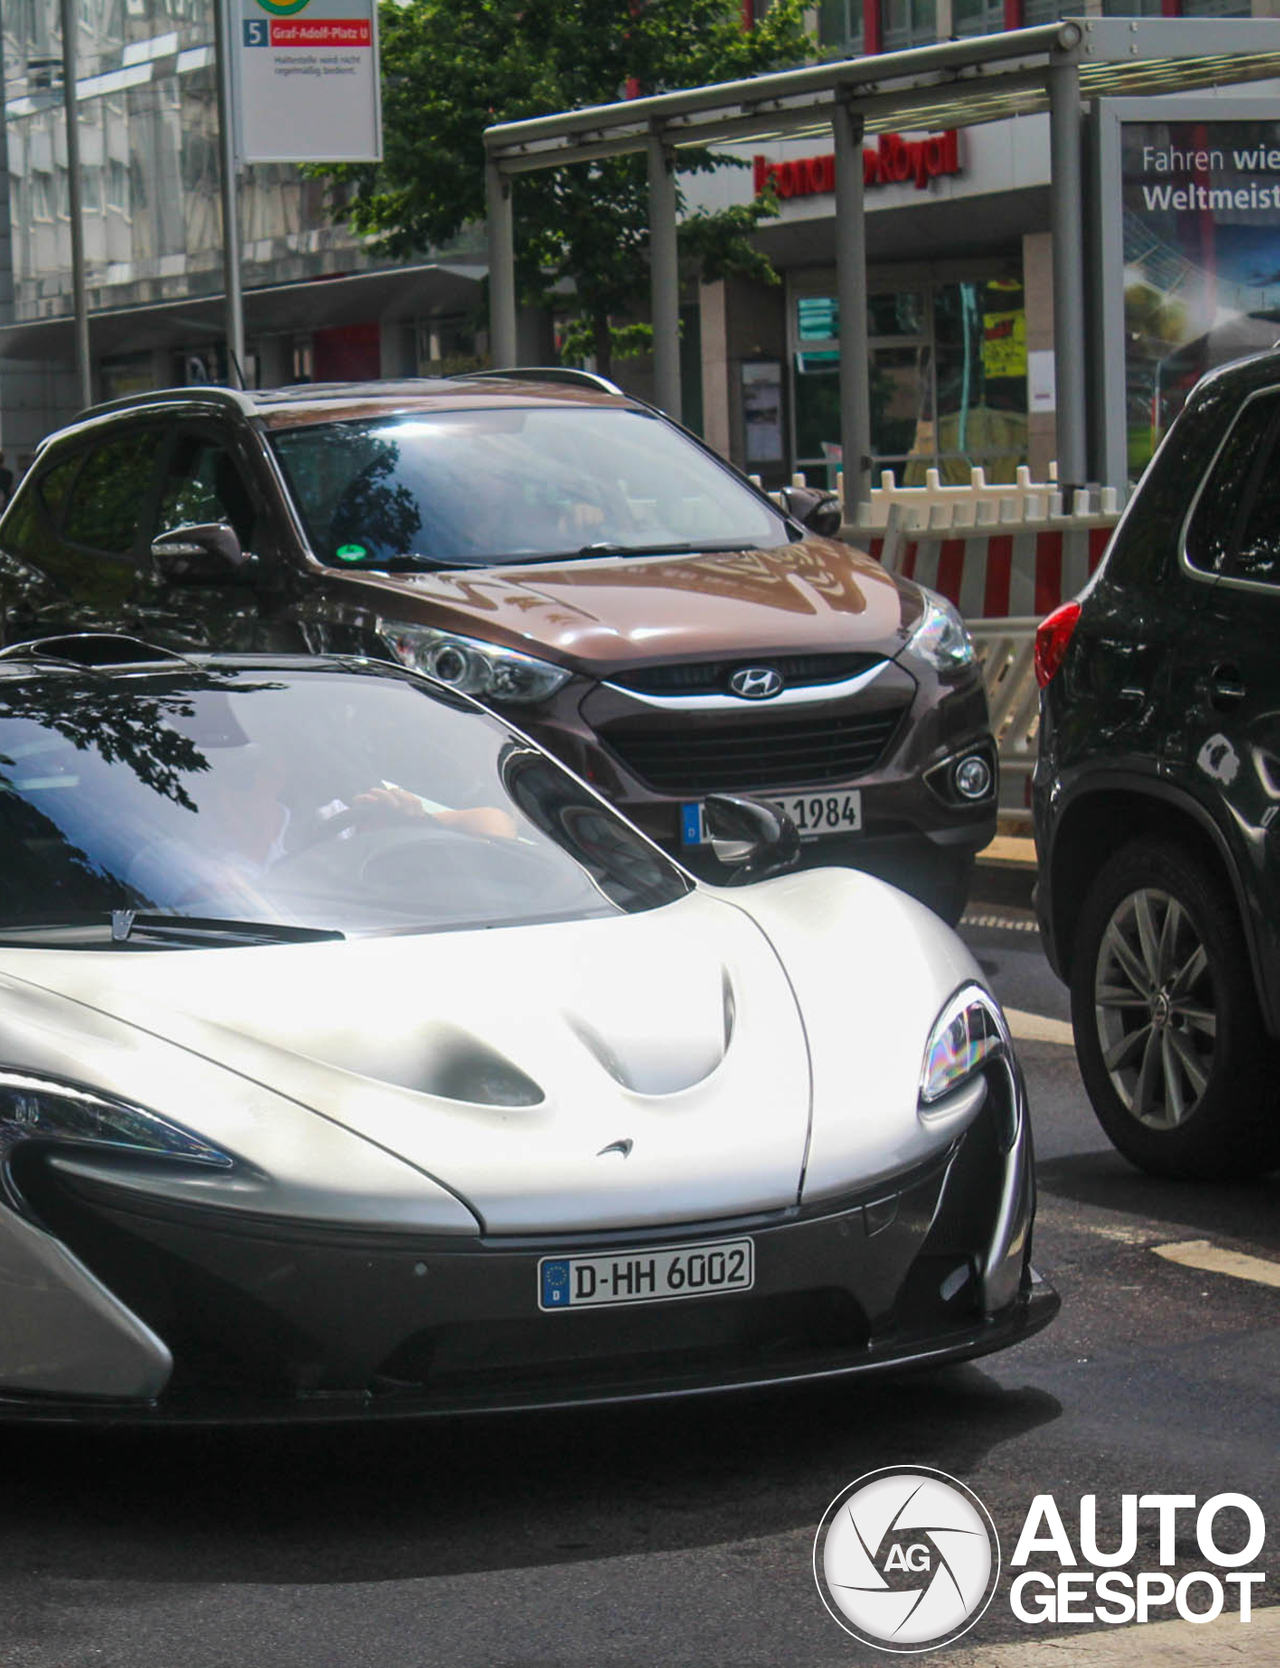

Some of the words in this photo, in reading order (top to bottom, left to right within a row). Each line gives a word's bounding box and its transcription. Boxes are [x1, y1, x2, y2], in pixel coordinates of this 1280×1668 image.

[249, 22, 261, 45] 5
[272, 26, 357, 40] Graf-Adolf-Platz
[1143, 144, 1224, 172] Fahren
[1233, 144, 1280, 170] wie
[793, 796, 856, 829] 1984
[575, 1259, 656, 1299] D-HH
[667, 1250, 745, 1290] 6002
